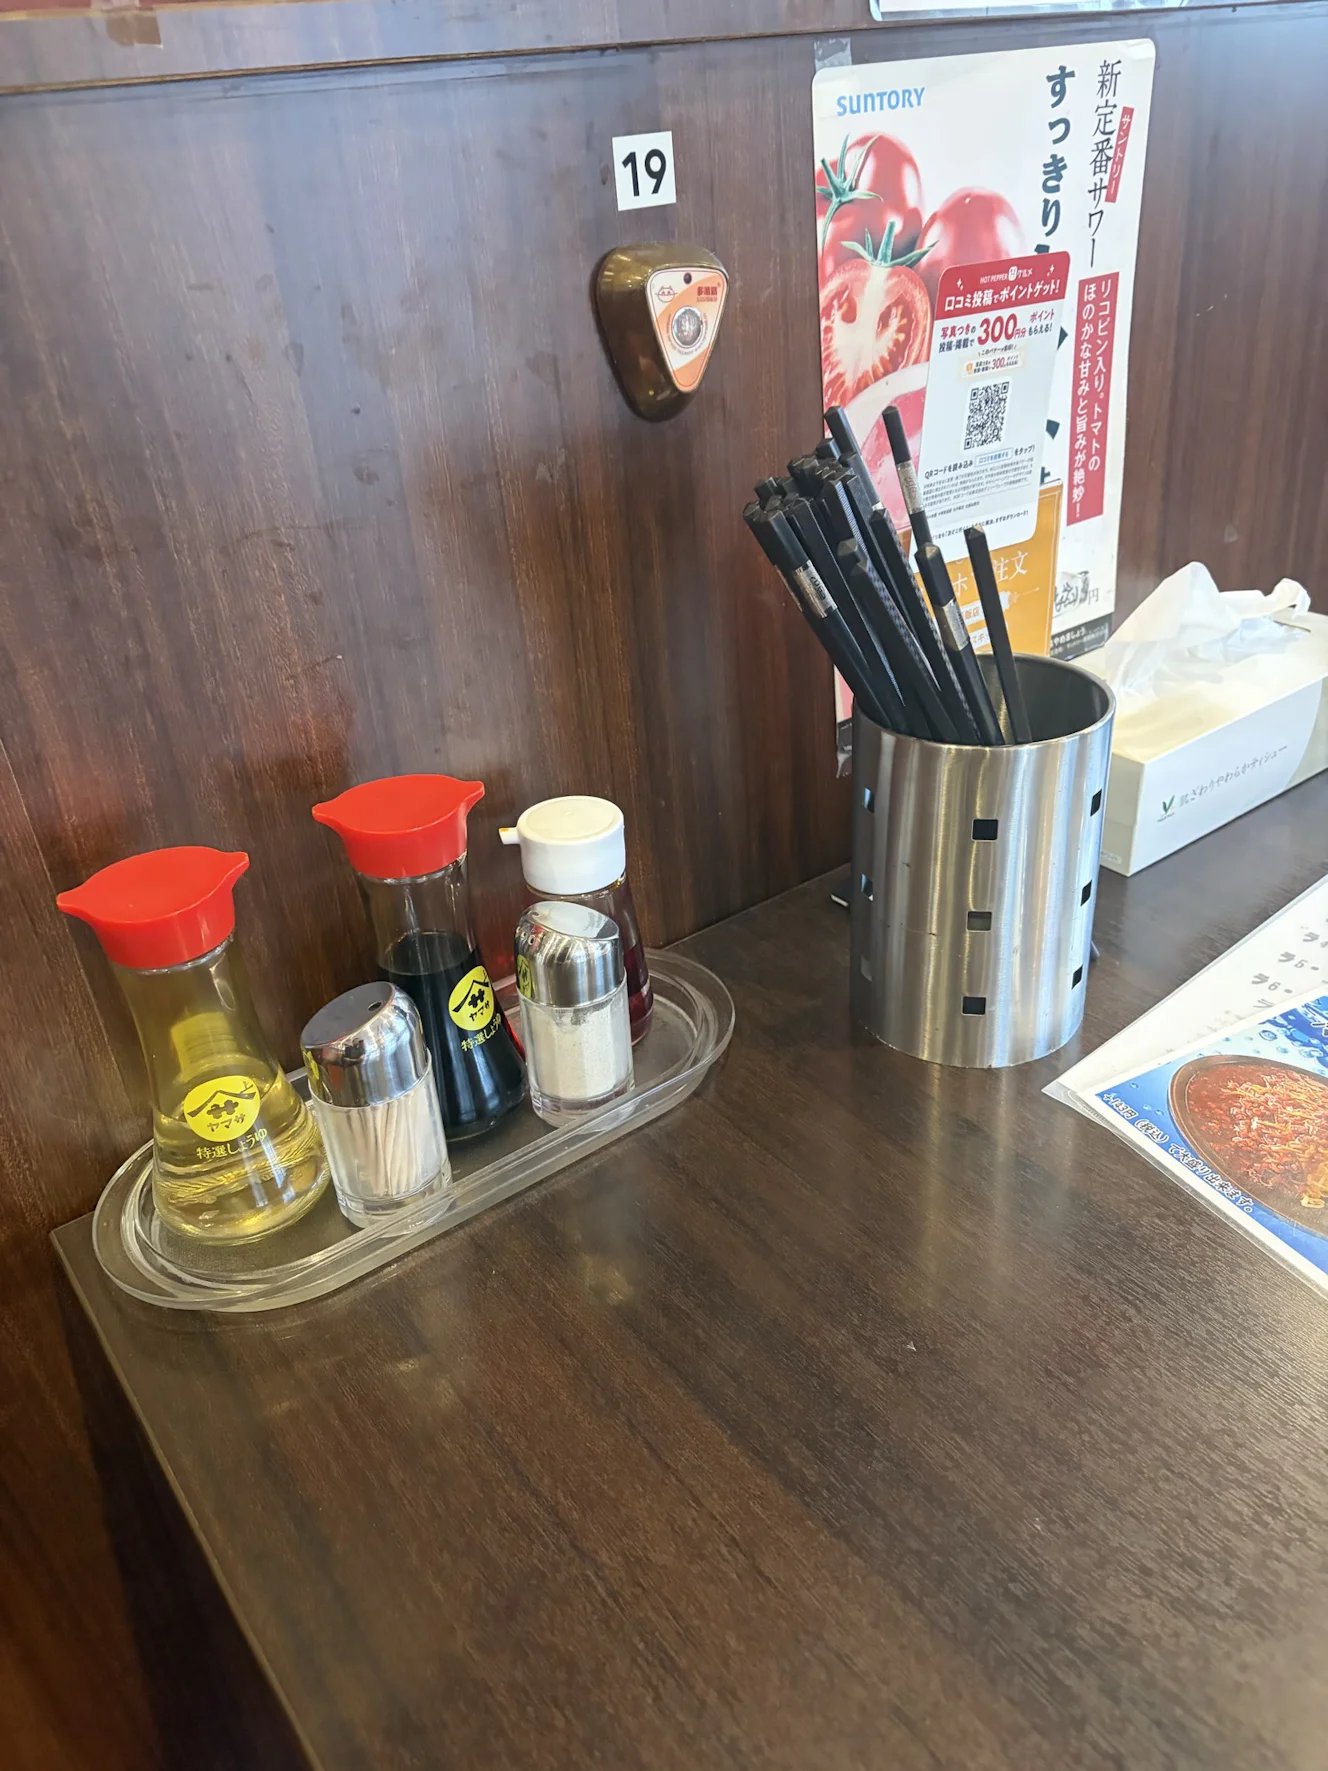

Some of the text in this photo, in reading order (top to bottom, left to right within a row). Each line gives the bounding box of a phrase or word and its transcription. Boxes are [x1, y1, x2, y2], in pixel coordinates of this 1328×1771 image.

[836, 87, 926, 117] SUNTORY
[621, 148, 667, 197] 19
[1035, 66, 1076, 254] すっきり
[1087, 59, 1121, 268] 新定番サワー
[1109, 115, 1131, 195] サントリー
[1030, 308, 1055, 323] ポイント
[195, 1127, 269, 1160] 特選しょうゆ
[206, 1113, 246, 1133] ヤマサ
